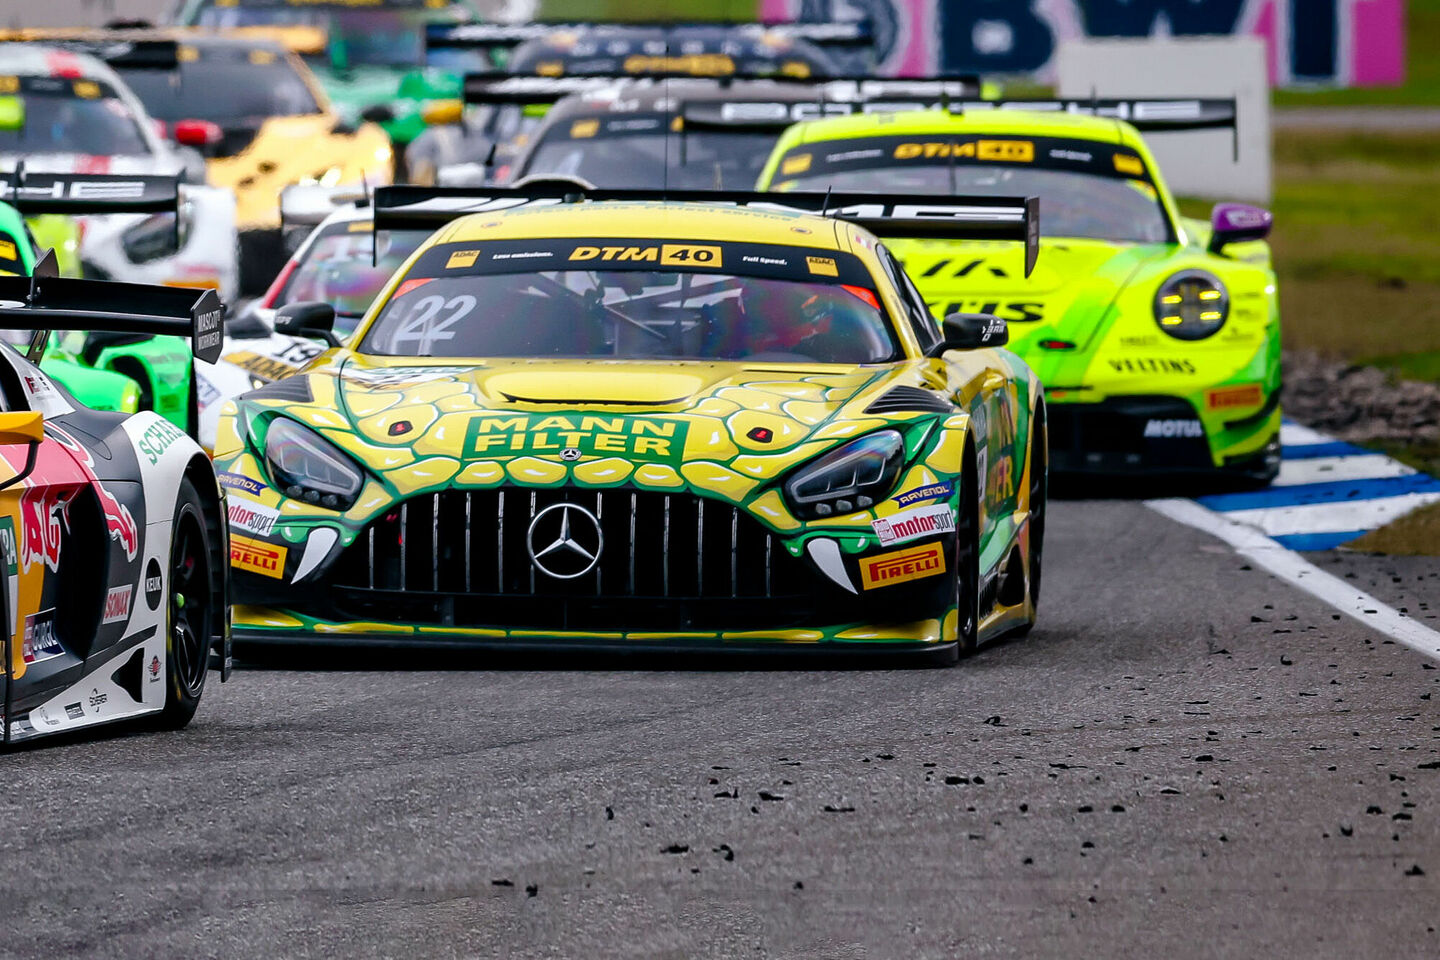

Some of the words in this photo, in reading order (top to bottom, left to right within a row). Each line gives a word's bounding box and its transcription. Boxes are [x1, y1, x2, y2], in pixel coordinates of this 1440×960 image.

[568, 246, 658, 262] DTM
[670, 248, 714, 262] 40
[743, 255, 759, 263] Full
[760, 256, 787, 266] Speed.
[393, 295, 477, 341] 22
[1109, 359, 1196, 374] VELTINS
[478, 416, 677, 437] MANN
[1144, 420, 1203, 437] MOTUL
[475, 432, 671, 456] FILTER
[899, 486, 950, 504] RAVENOL
[227, 505, 276, 534] otorsport
[892, 511, 955, 539] motorsport
[231, 540, 279, 571] RELLI
[868, 550, 939, 582] PIRELLI
